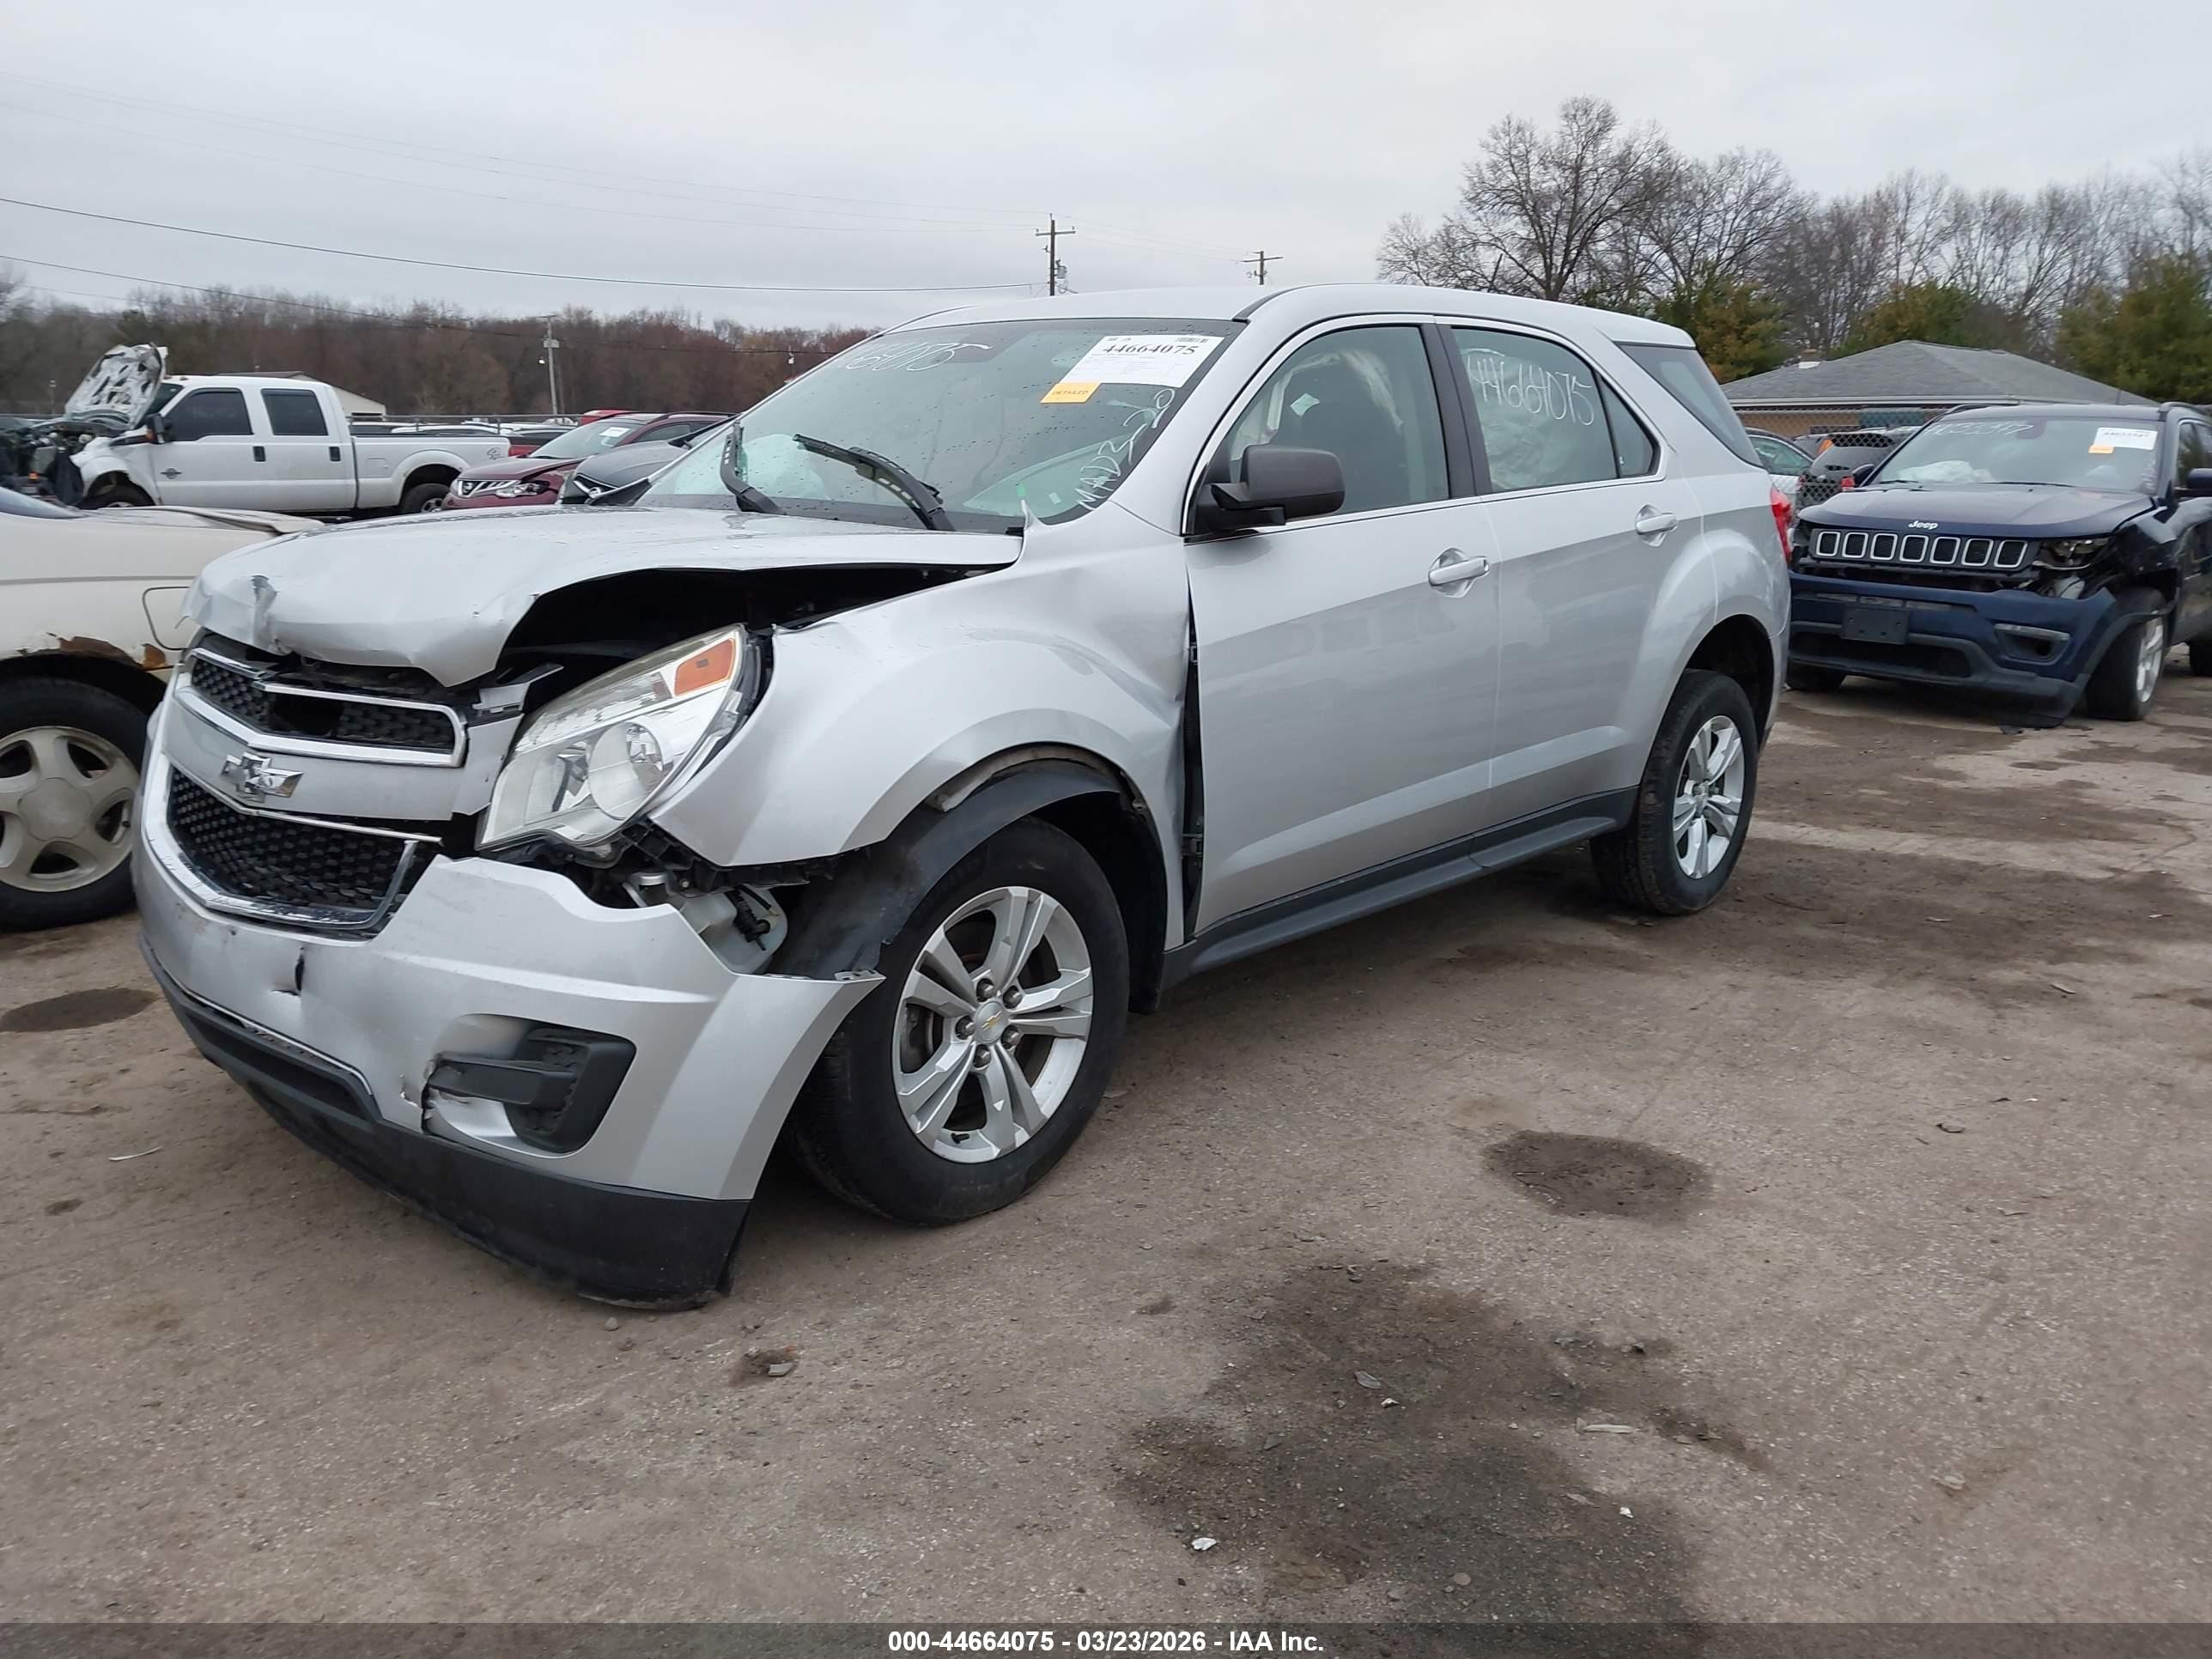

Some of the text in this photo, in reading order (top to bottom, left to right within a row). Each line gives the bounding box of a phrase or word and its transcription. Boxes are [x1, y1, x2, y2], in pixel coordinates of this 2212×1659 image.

[1103, 343, 1200, 355] 44664075
[1467, 354, 1595, 426] 44664075
[1908, 520, 1938, 531] Jeep
